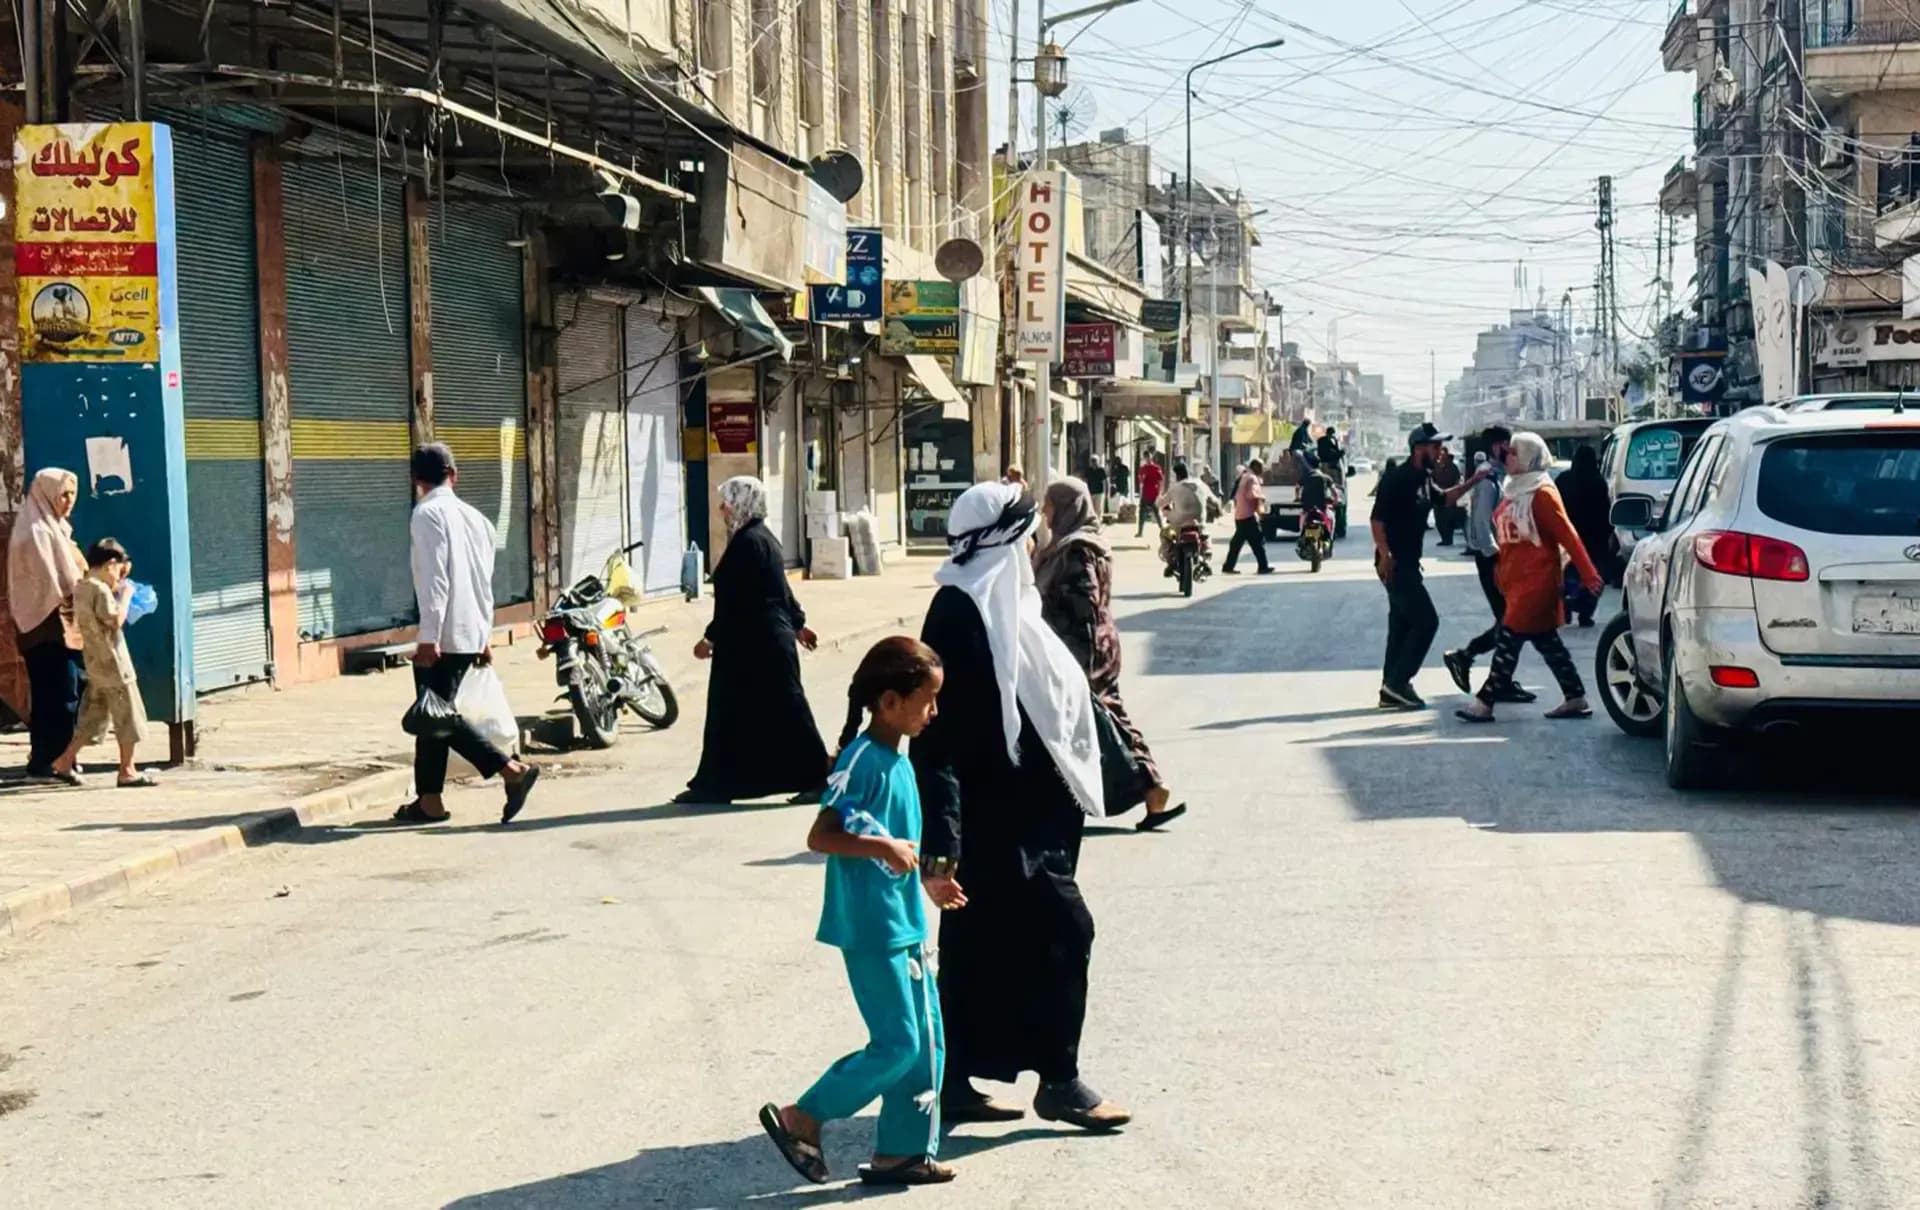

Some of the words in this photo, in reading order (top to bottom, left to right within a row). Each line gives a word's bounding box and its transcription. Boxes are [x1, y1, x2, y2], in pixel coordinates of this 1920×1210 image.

[31, 137, 141, 189] كوليلك
[32, 206, 137, 233] للاتصالات
[1026, 181, 1051, 323] HOTEL
